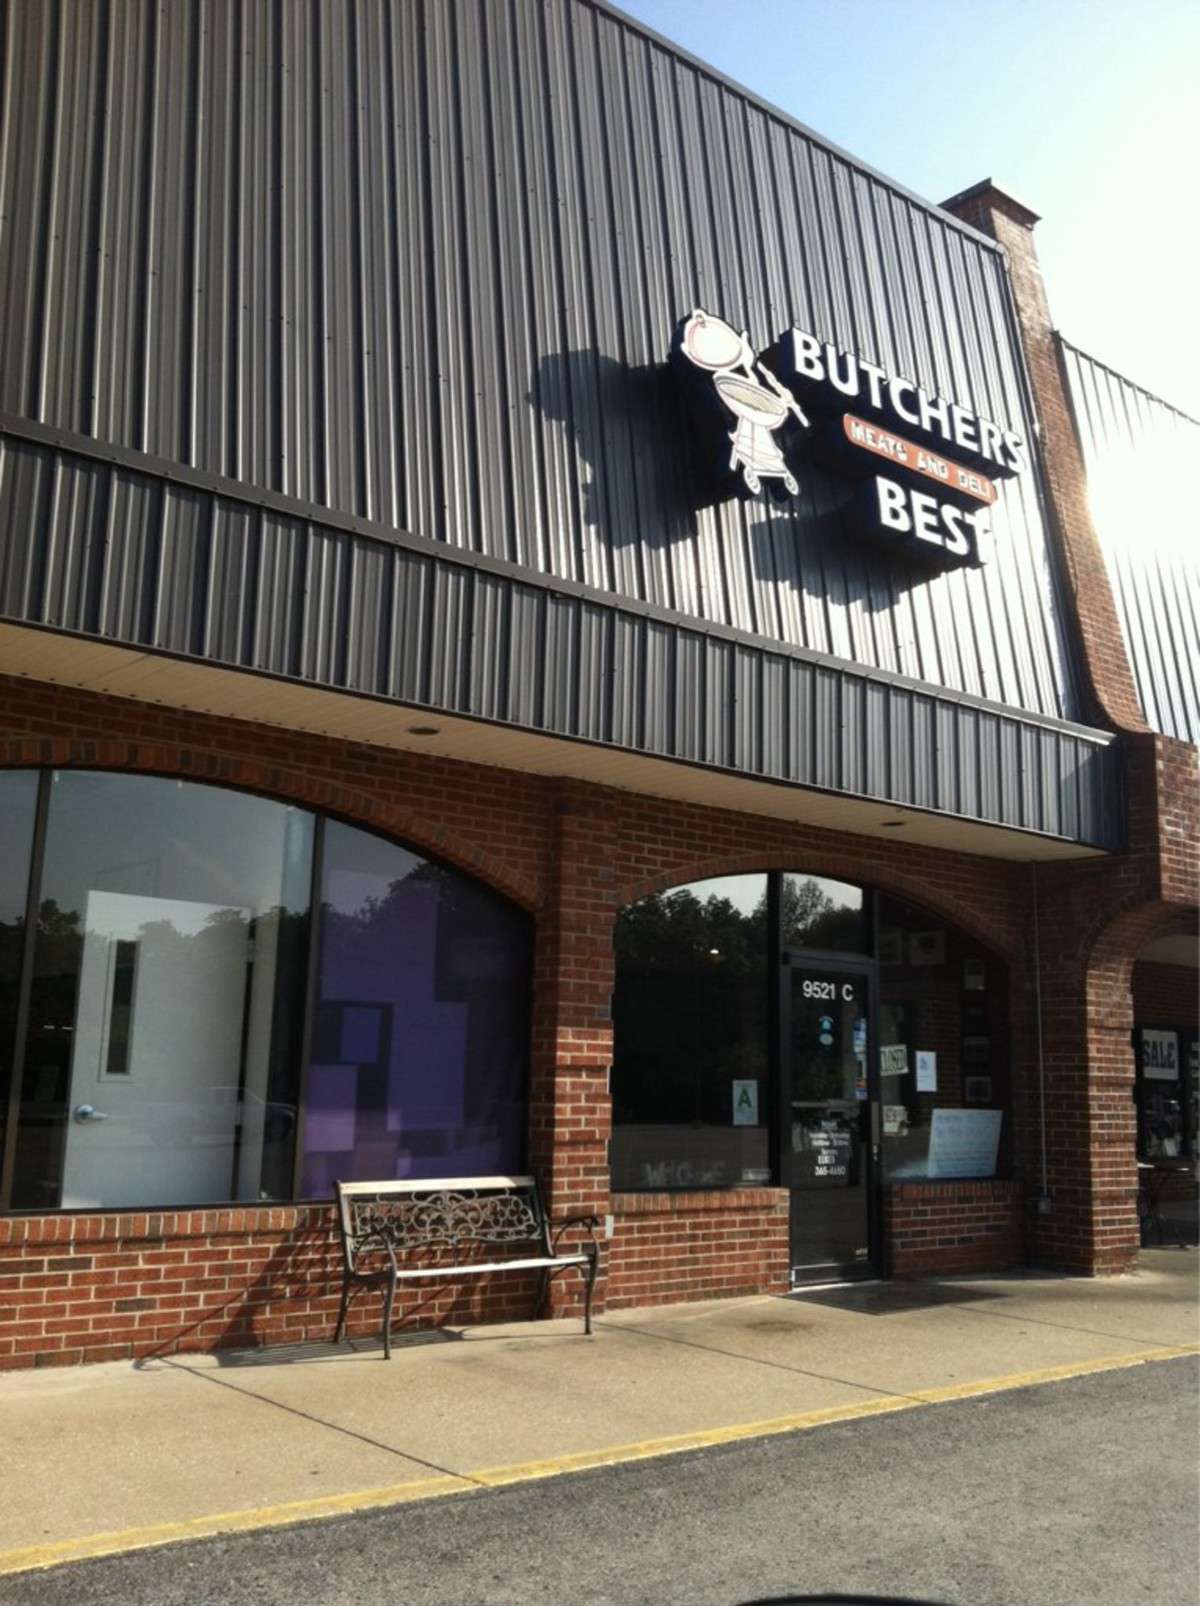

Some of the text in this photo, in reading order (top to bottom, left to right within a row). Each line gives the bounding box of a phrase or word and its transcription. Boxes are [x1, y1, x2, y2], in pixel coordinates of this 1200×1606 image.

[792, 326, 1025, 475] BUTCHERS
[850, 420, 908, 461] MEATS
[915, 451, 949, 480] AND
[876, 475, 992, 565] BEST
[802, 980, 854, 1001] 9521 C
[1143, 1039, 1176, 1069] SALE
[737, 1087, 753, 1109] A
